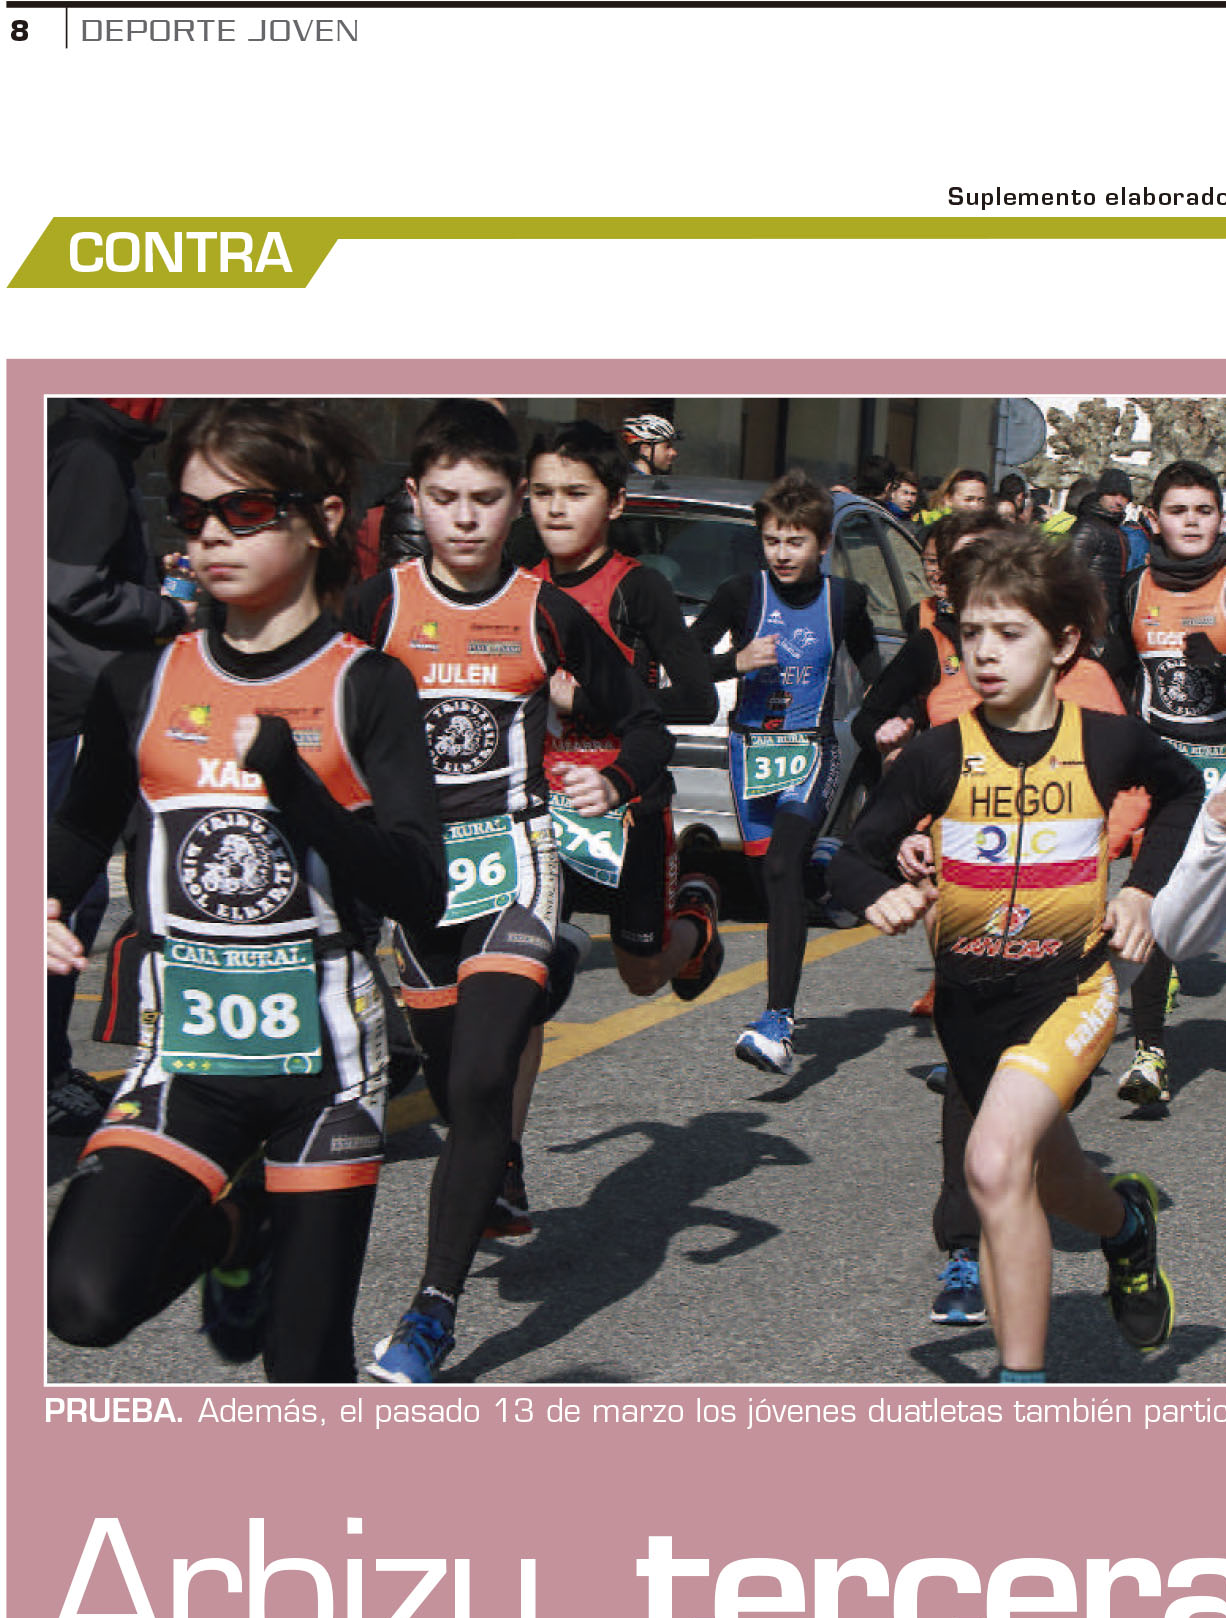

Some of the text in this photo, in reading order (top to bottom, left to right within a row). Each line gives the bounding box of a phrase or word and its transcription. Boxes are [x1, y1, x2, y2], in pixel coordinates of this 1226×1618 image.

[10, 19, 29, 42] 8
[81, 19, 358, 42] DEPORTE JOVEN
[948, 186, 1096, 211] Suplemento
[69, 231, 293, 273] CONTRA
[422, 662, 498, 686] JULEN
[754, 754, 807, 781] 310
[971, 780, 1073, 818] HEGOI
[181, 988, 301, 1041] 308
[45, 1397, 183, 1423] PRUEBA.
[197, 1397, 326, 1426] Además,
[340, 1397, 363, 1423] el
[375, 1397, 480, 1430] pasado
[495, 1397, 534, 1423] 13
[546, 1397, 581, 1423] de
[593, 1404, 684, 1423] marzo
[696, 1397, 737, 1423] los
[746, 1397, 857, 1430] jóvenes
[868, 1397, 1003, 1423] duatletas
[1013, 1397, 1132, 1423] también
